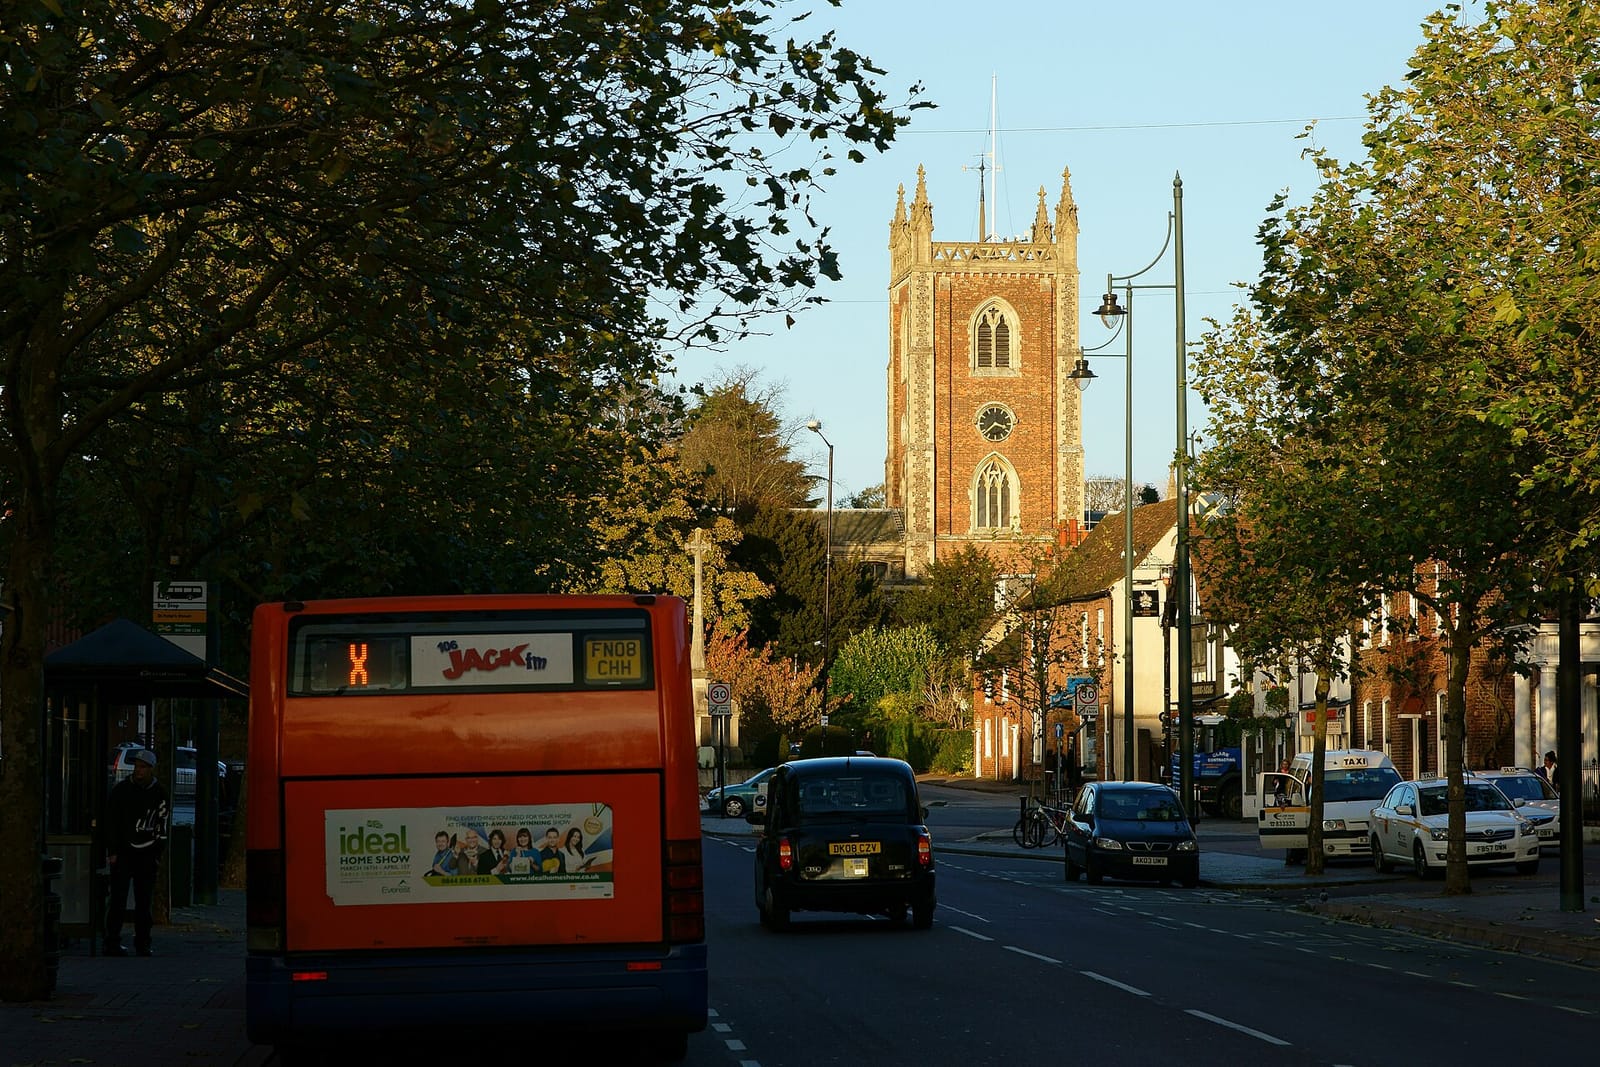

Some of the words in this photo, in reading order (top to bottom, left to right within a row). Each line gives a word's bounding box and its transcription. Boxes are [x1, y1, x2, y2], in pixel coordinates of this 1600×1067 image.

[437, 641, 458, 653] 106
[592, 642, 636, 657] FN08
[349, 643, 368, 686] X
[442, 643, 530, 680] JACK
[525, 652, 547, 670] fm
[598, 660, 631, 675] CHH
[713, 690, 727, 698] 30
[1081, 690, 1095, 699] 30
[1343, 758, 1366, 766] TAXI
[460, 814, 495, 822] EVERYTHING
[468, 819, 551, 828] MULTI-AWARD-WINNING
[339, 825, 411, 855] ideal
[833, 844, 857, 853] DK08
[340, 856, 373, 865] HOME
[376, 854, 410, 864] SHOW
[509, 872, 600, 882] www.idealhomeshow.co.uk
